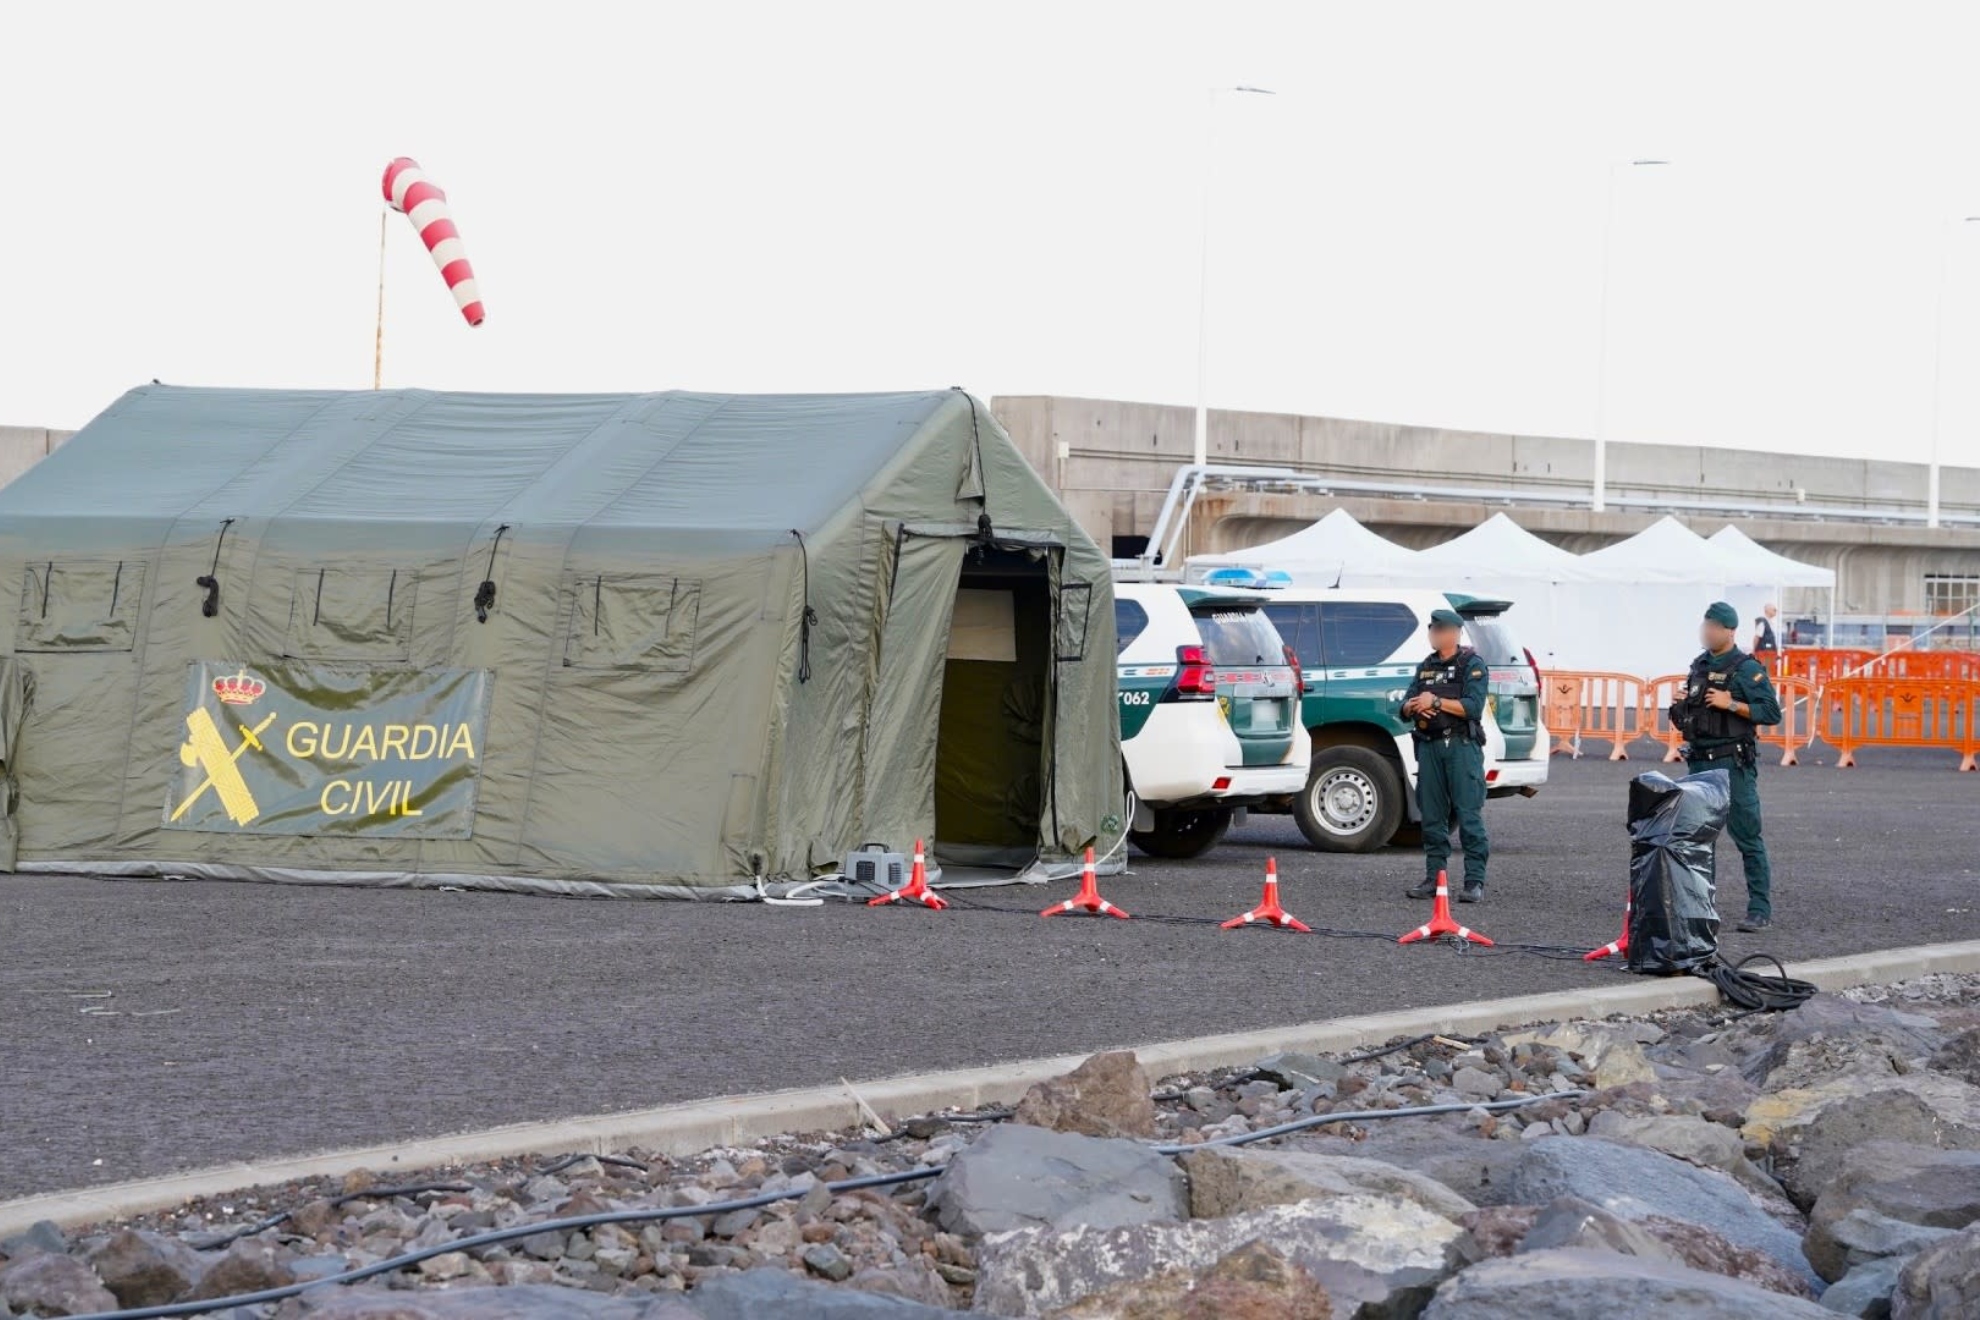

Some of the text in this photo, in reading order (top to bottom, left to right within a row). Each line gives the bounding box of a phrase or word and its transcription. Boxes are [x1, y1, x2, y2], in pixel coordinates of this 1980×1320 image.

[1123, 691, 1150, 705] 062
[287, 722, 475, 760] GUARDIA
[320, 780, 423, 816] CIVIL
